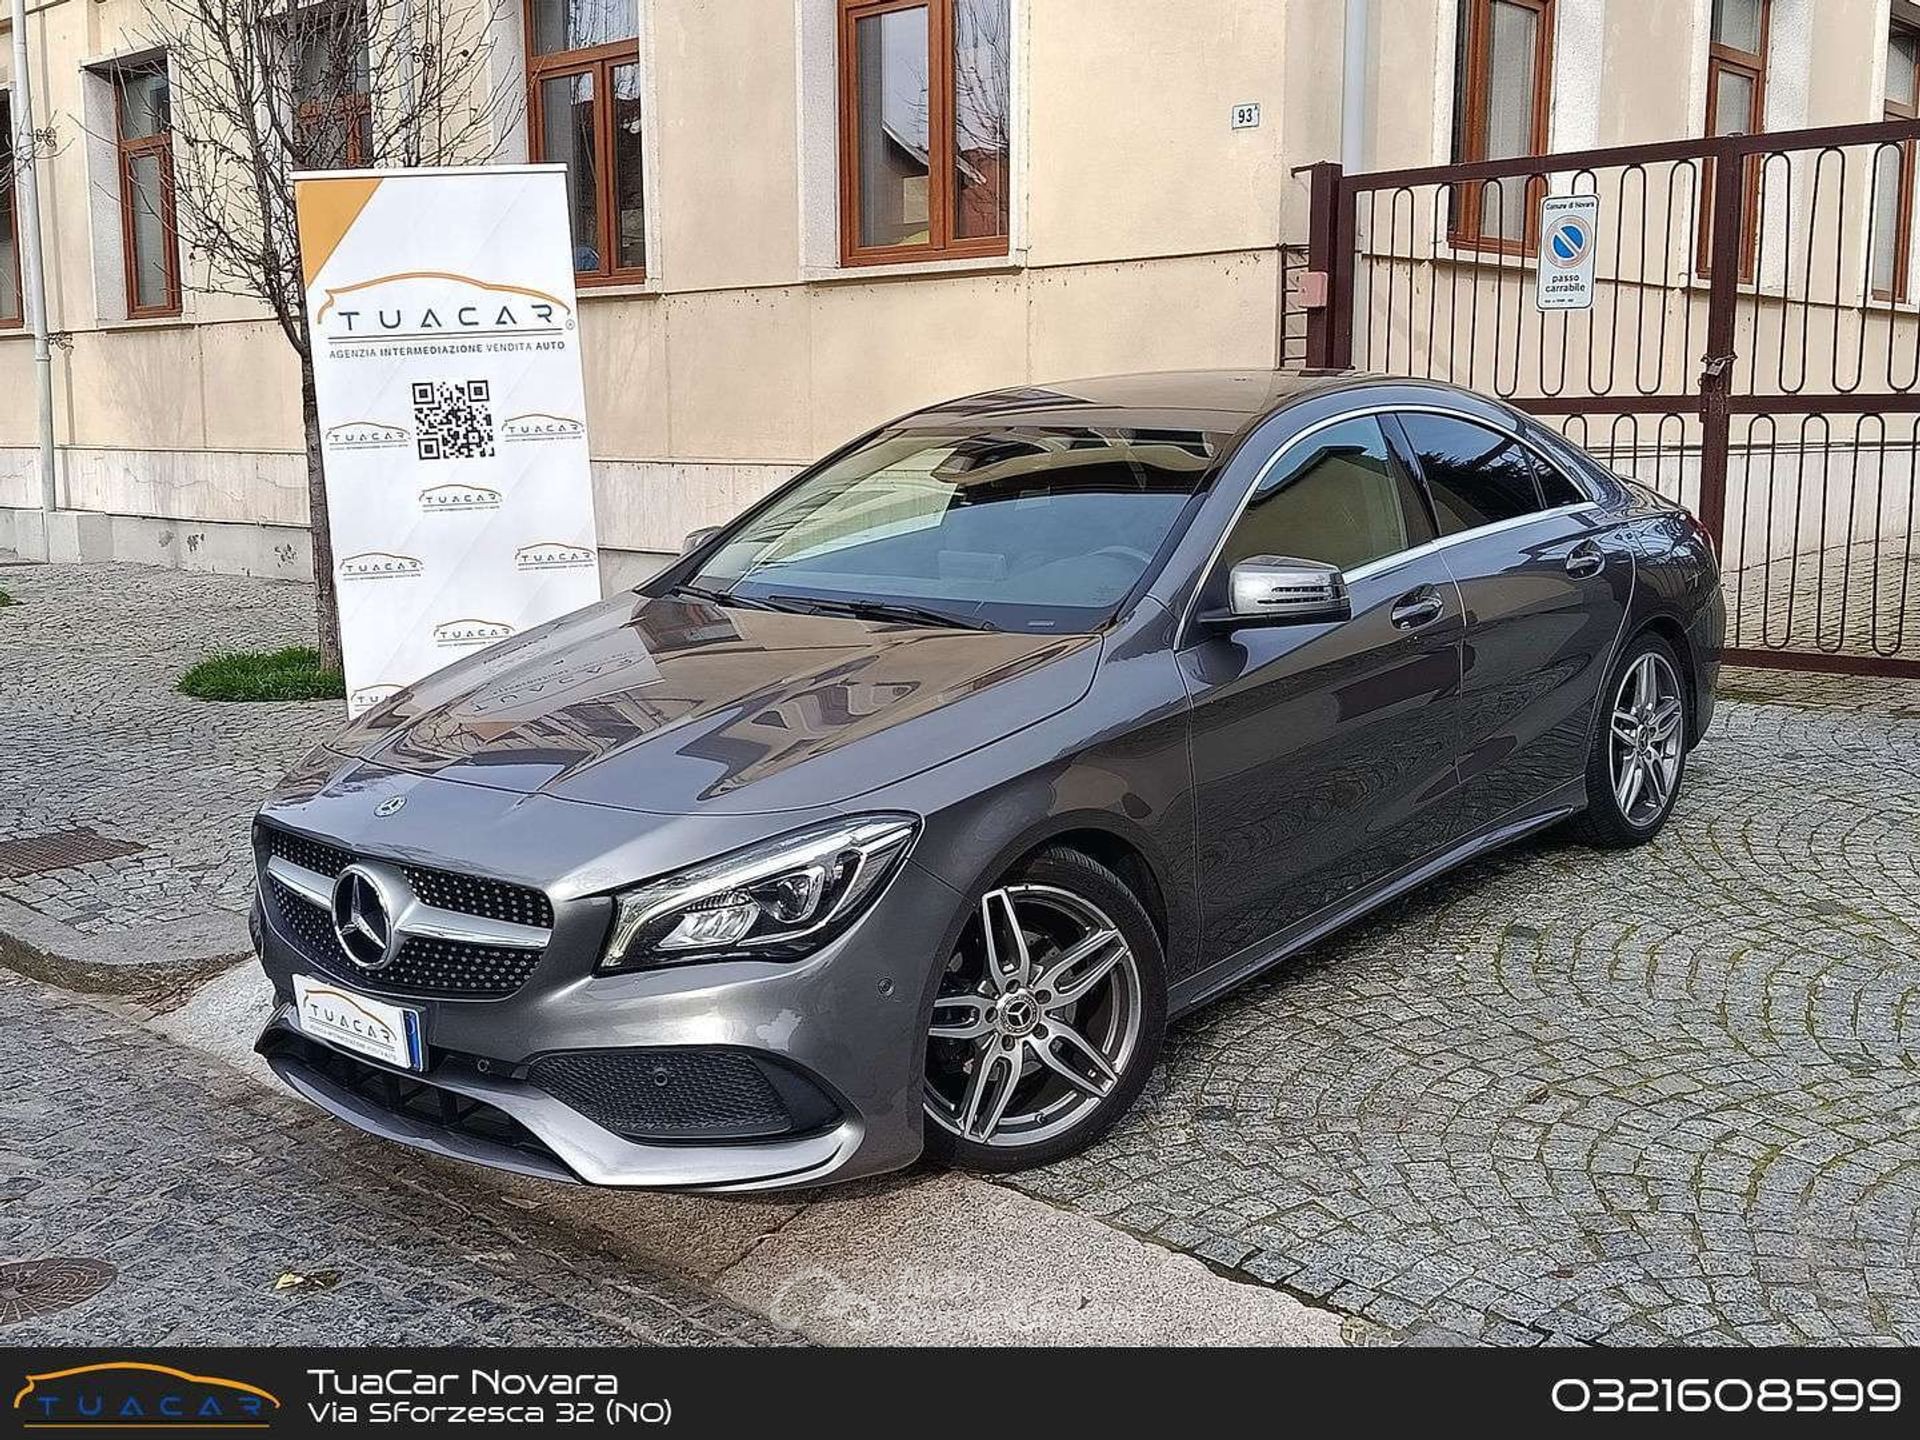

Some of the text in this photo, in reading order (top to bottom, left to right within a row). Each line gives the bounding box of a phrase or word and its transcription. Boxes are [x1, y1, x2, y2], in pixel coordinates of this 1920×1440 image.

[1552, 274, 1580, 284] passo
[1545, 282, 1586, 293] carrabile
[337, 303, 553, 332] TUACAR
[329, 340, 566, 359] AGENZIA INTERMEDIAZIONE VENDITA AUTO
[507, 423, 580, 434] TUACAR
[332, 431, 405, 442] TUACAR
[425, 492, 497, 504] TUACAR
[520, 552, 592, 563] TUACAR
[345, 561, 418, 572] TUACAR
[439, 628, 512, 640] TUACAR
[309, 1003, 392, 1044] TUACAR
